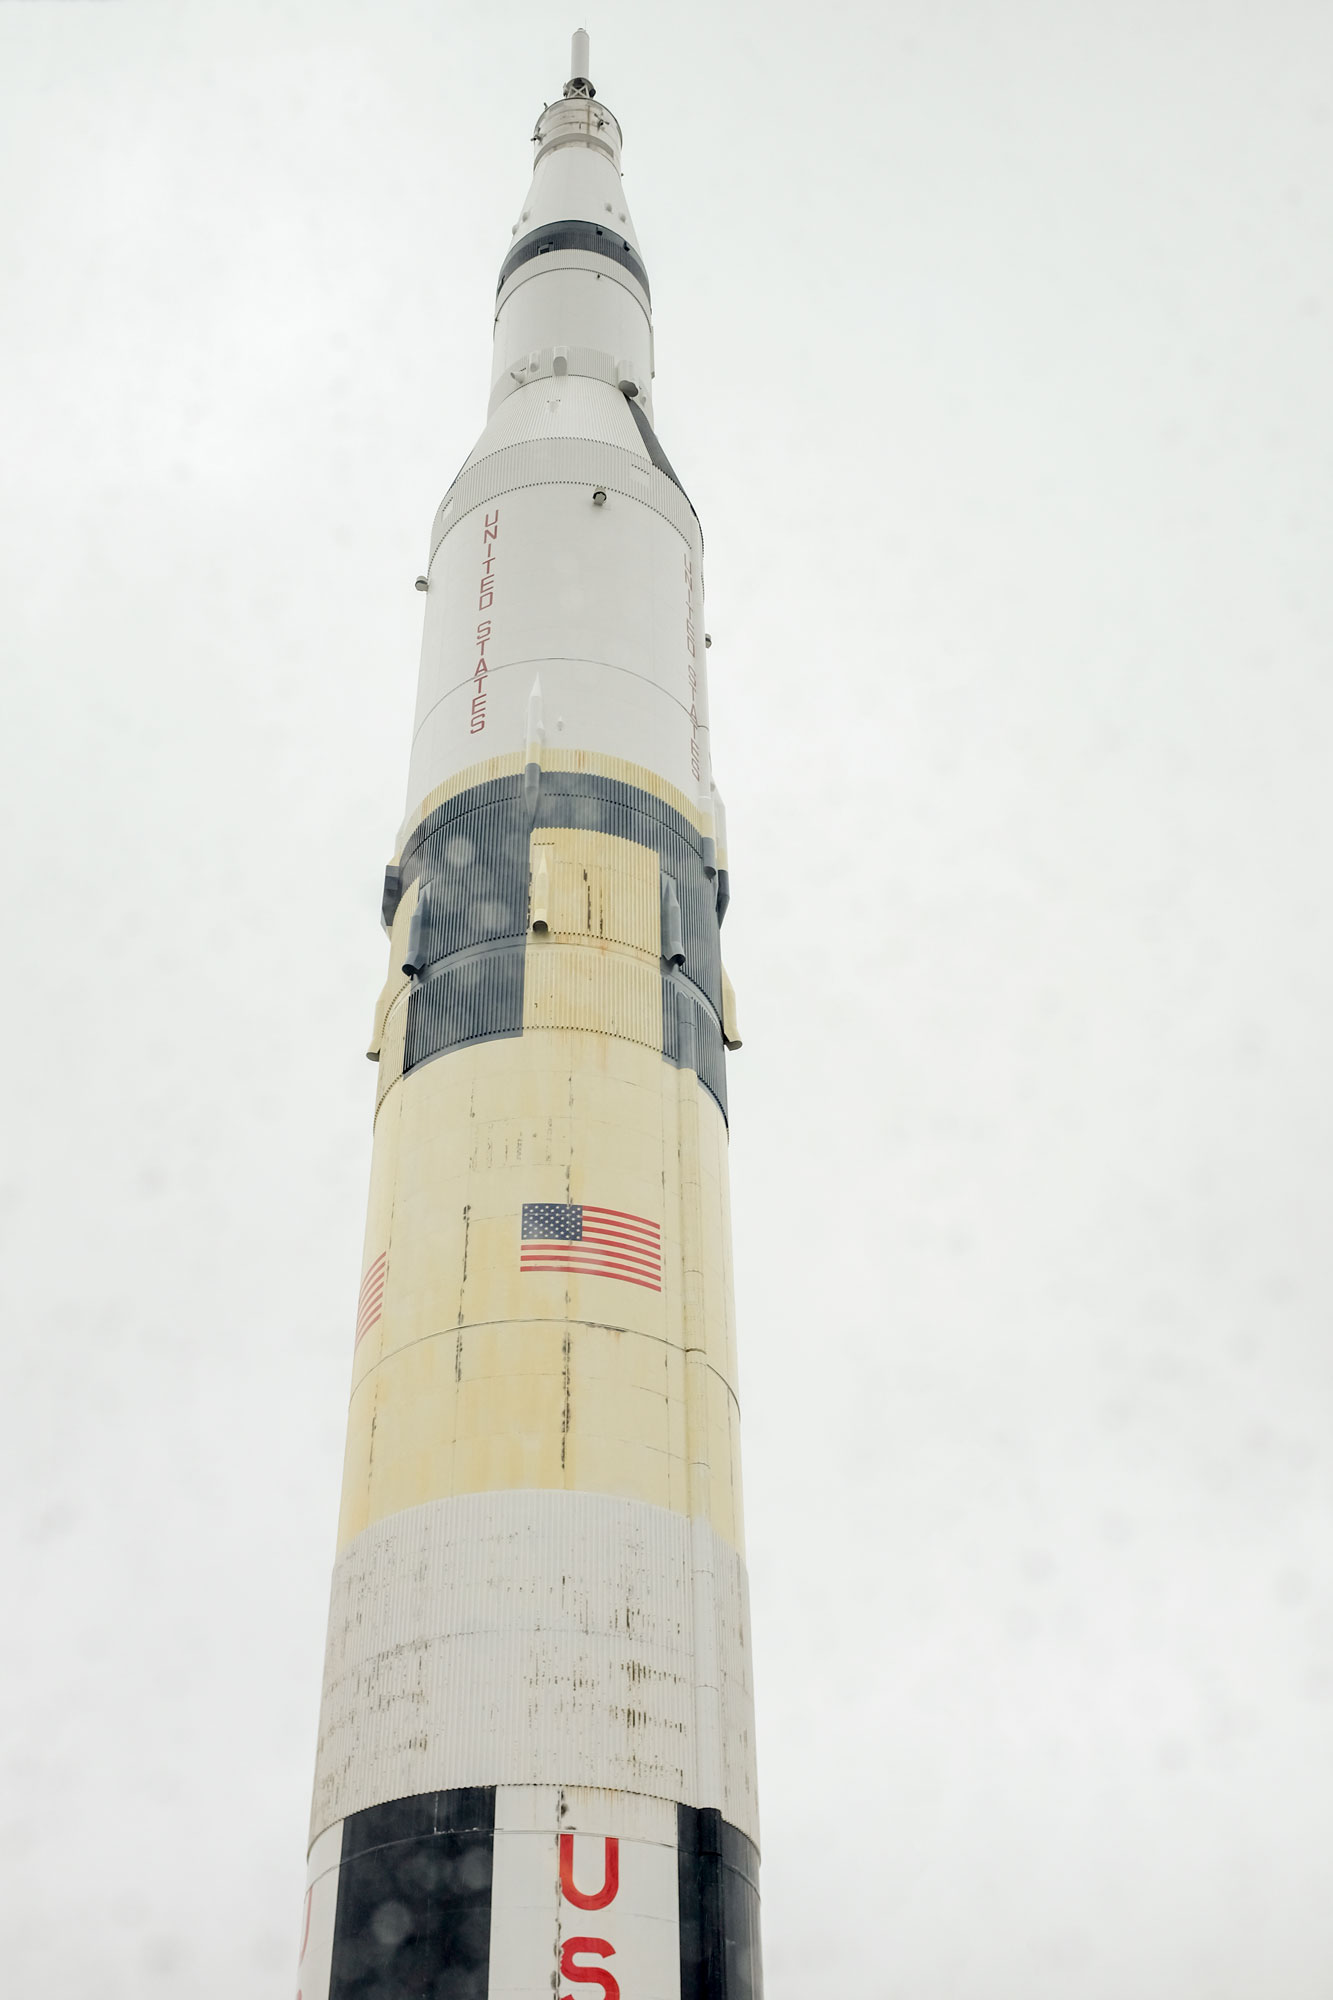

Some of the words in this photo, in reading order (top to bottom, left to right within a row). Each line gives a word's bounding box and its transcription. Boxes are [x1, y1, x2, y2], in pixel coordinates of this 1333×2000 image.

[479, 509, 499, 611] UNITED
[470, 620, 491, 734] STATES
[688, 664, 700, 781] STATES
